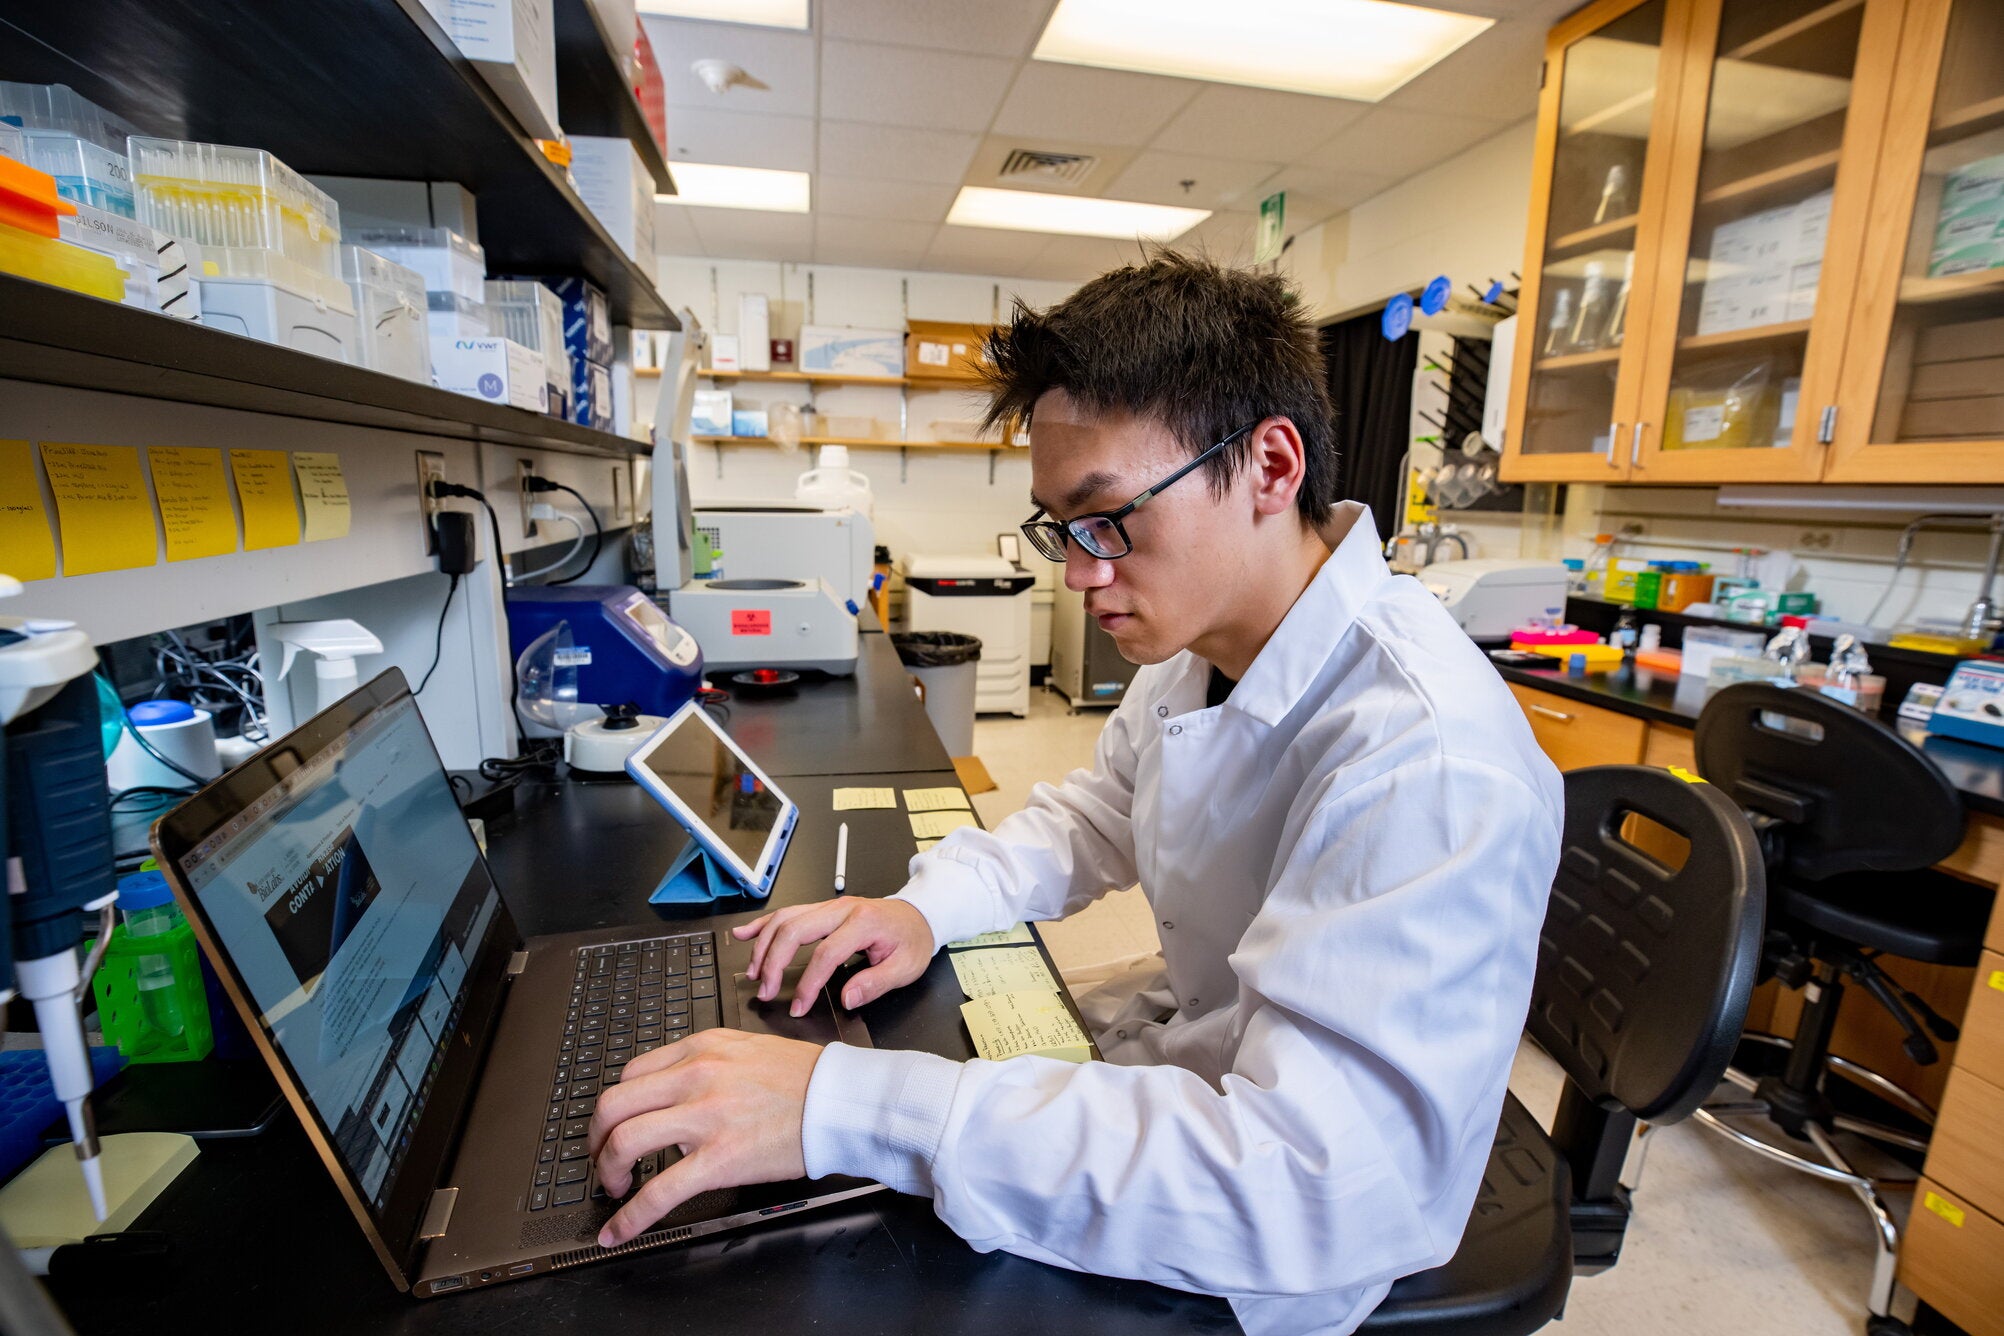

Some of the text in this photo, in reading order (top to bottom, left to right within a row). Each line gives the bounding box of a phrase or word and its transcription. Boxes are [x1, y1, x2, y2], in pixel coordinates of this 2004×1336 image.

[107, 162, 128, 181] 200
[75, 215, 114, 235] GILSON
[484, 379, 498, 393] M
